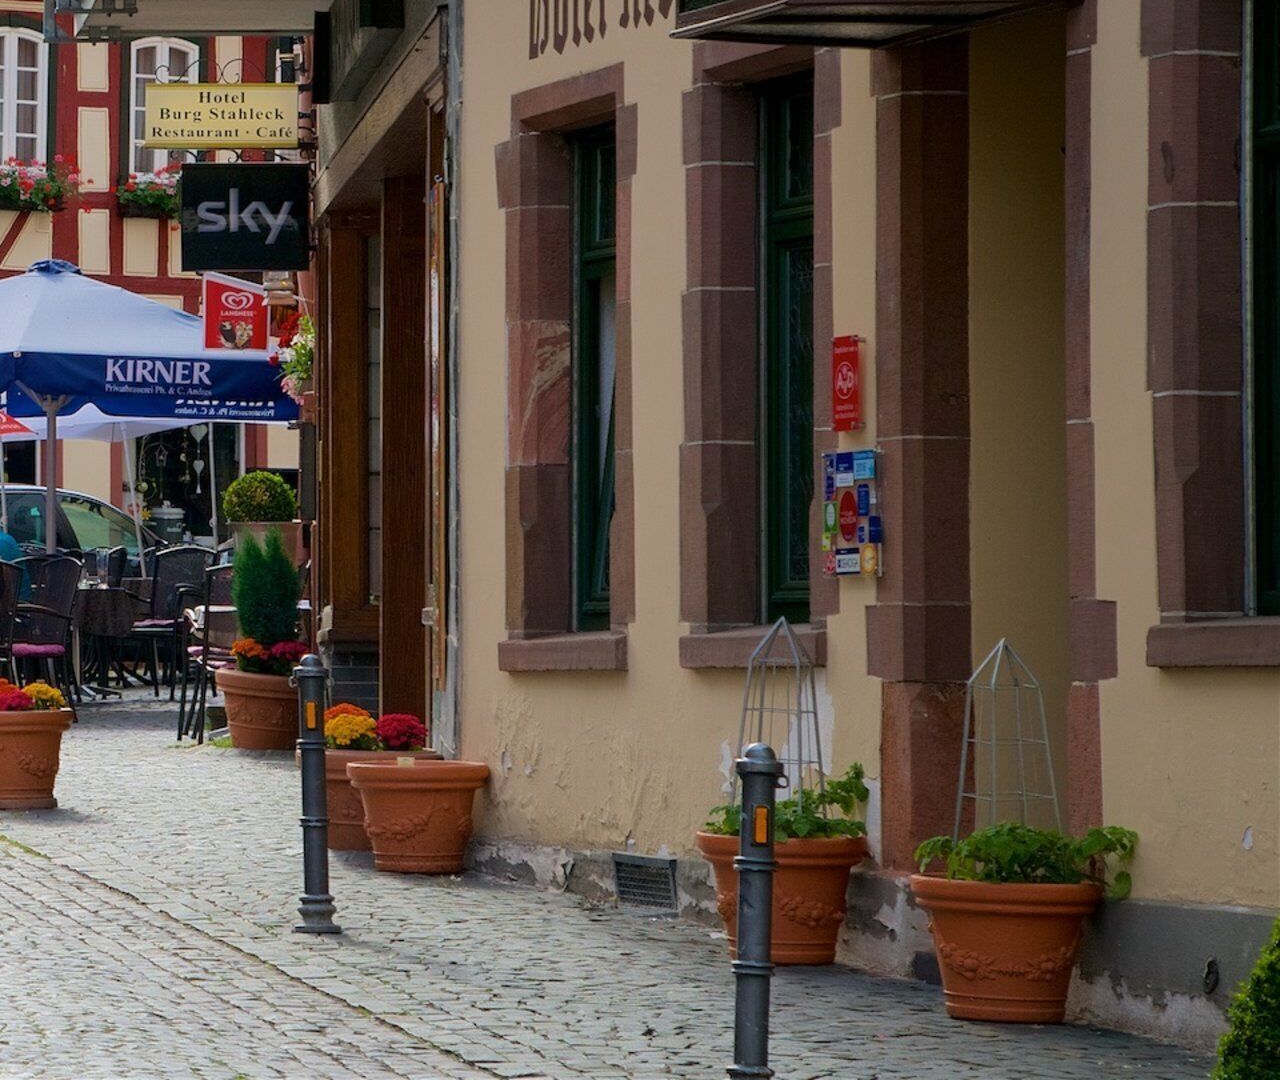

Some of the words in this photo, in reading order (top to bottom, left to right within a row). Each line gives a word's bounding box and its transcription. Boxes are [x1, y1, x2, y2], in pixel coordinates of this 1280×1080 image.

[199, 91, 246, 104] Hotel
[159, 107, 202, 122] Burg
[208, 107, 284, 120] Stahleck
[152, 126, 239, 138] Restaurant
[256, 126, 293, 138] Café
[197, 187, 294, 246] sky
[105, 358, 213, 386] KIRNER
